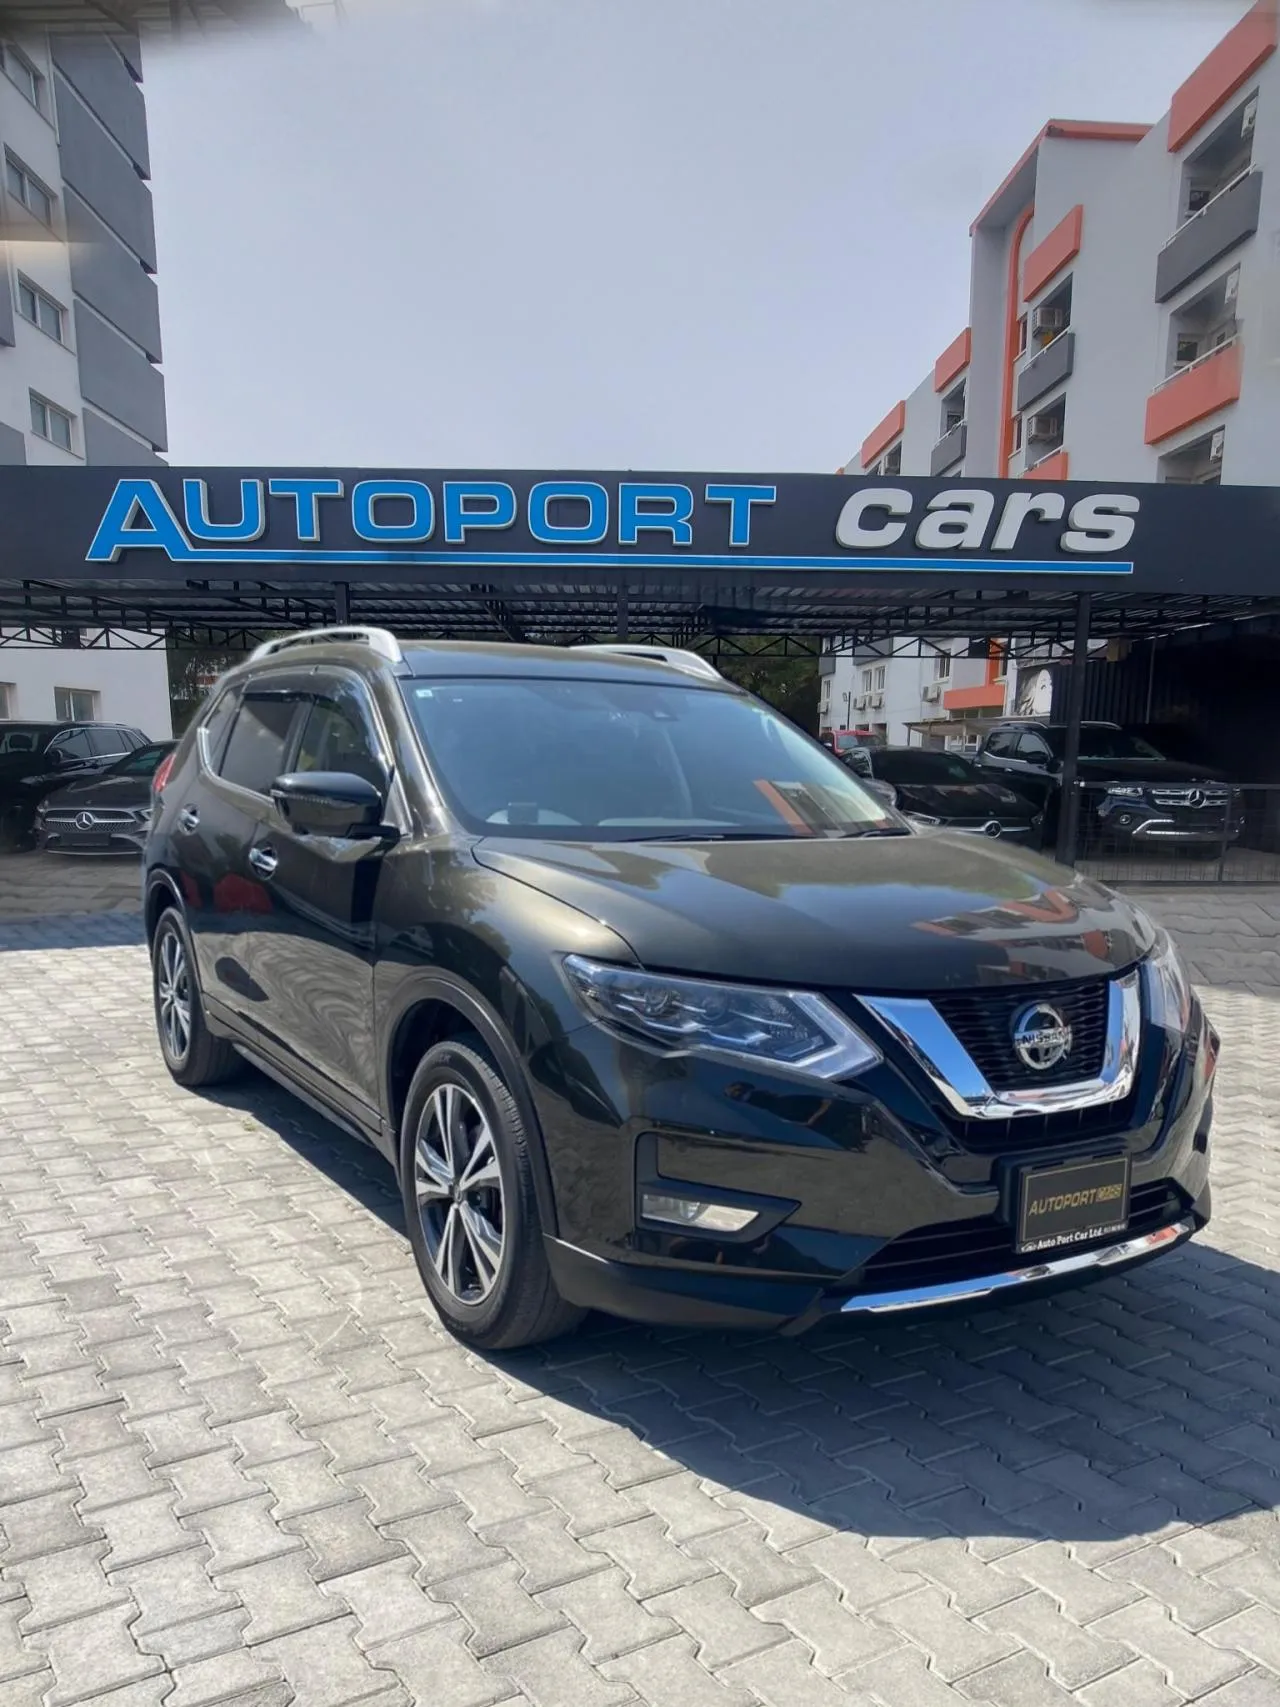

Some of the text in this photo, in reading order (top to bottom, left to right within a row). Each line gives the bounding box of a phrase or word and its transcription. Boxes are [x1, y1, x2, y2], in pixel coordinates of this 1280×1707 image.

[85, 478, 1141, 562] AUTOPORT cars
[1028, 1189, 1097, 1216] AUTOPORT
[1037, 1238, 1056, 1250] Auto
[1056, 1233, 1074, 1245] Port
[1074, 1230, 1089, 1241] Car
